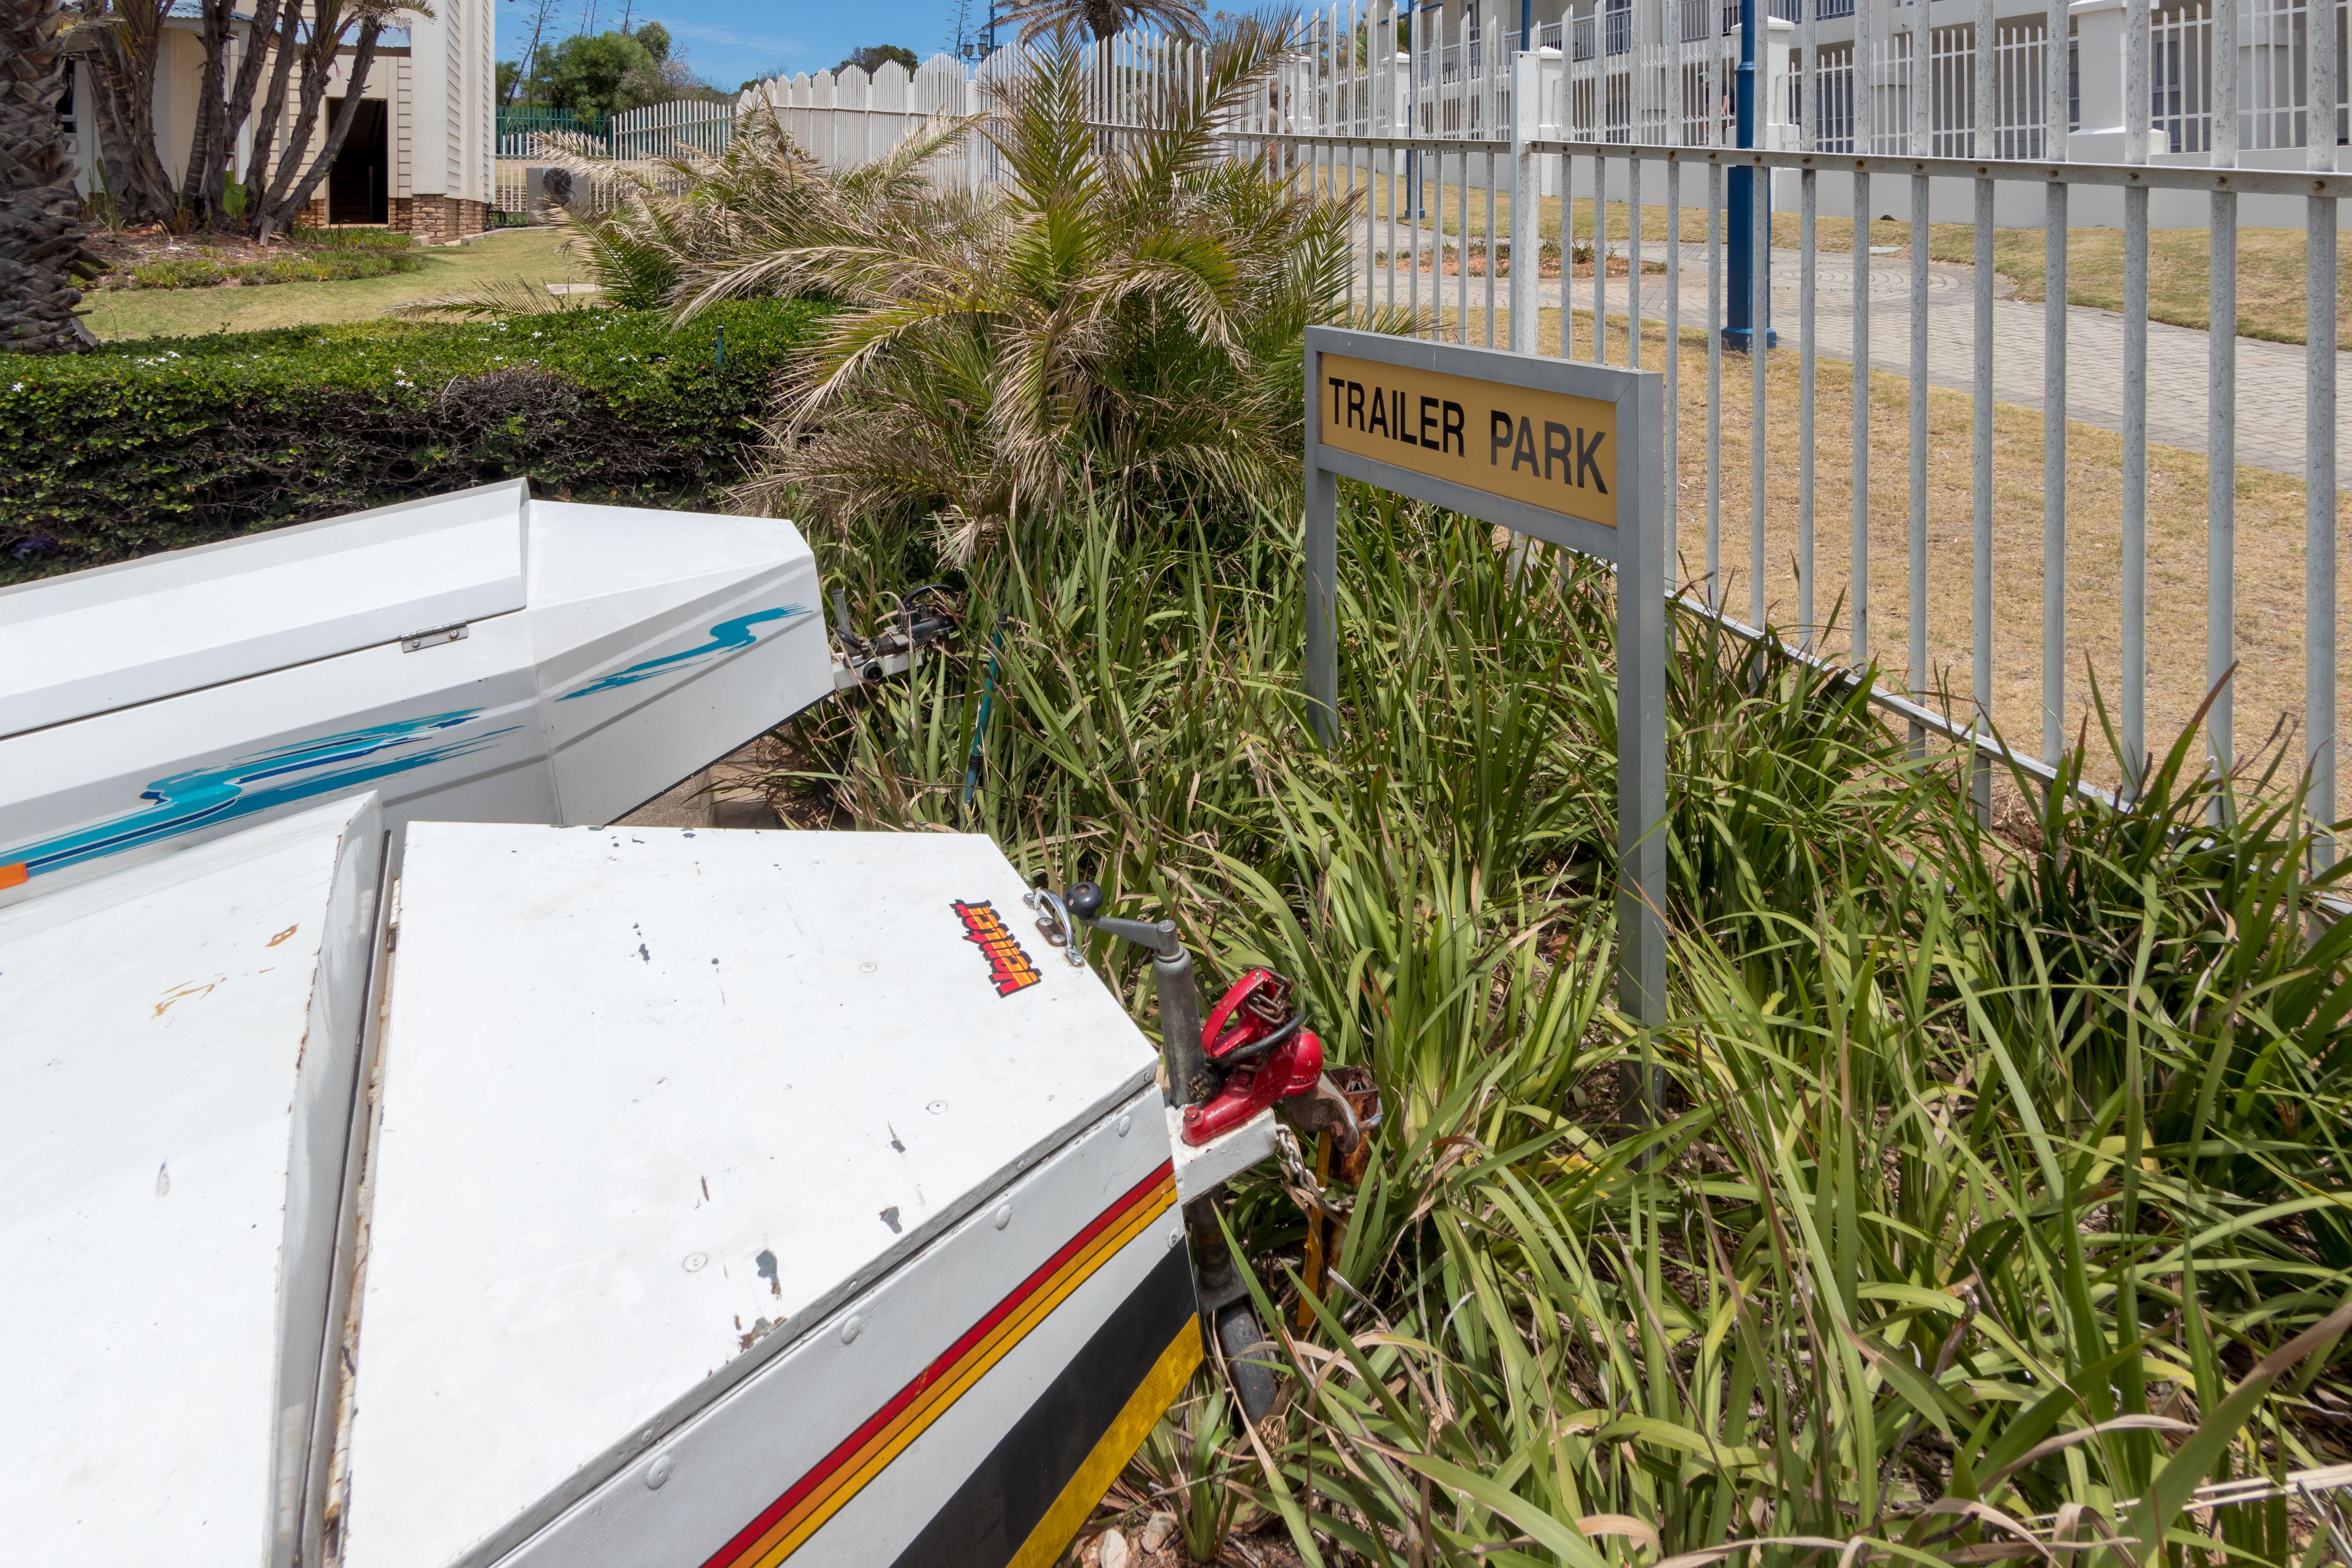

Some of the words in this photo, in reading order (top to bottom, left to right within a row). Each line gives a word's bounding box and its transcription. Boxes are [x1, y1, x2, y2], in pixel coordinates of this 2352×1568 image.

[1329, 377, 1465, 458] TRAILER
[1490, 409, 1608, 495] PARK
[949, 899, 1042, 998] Venter
